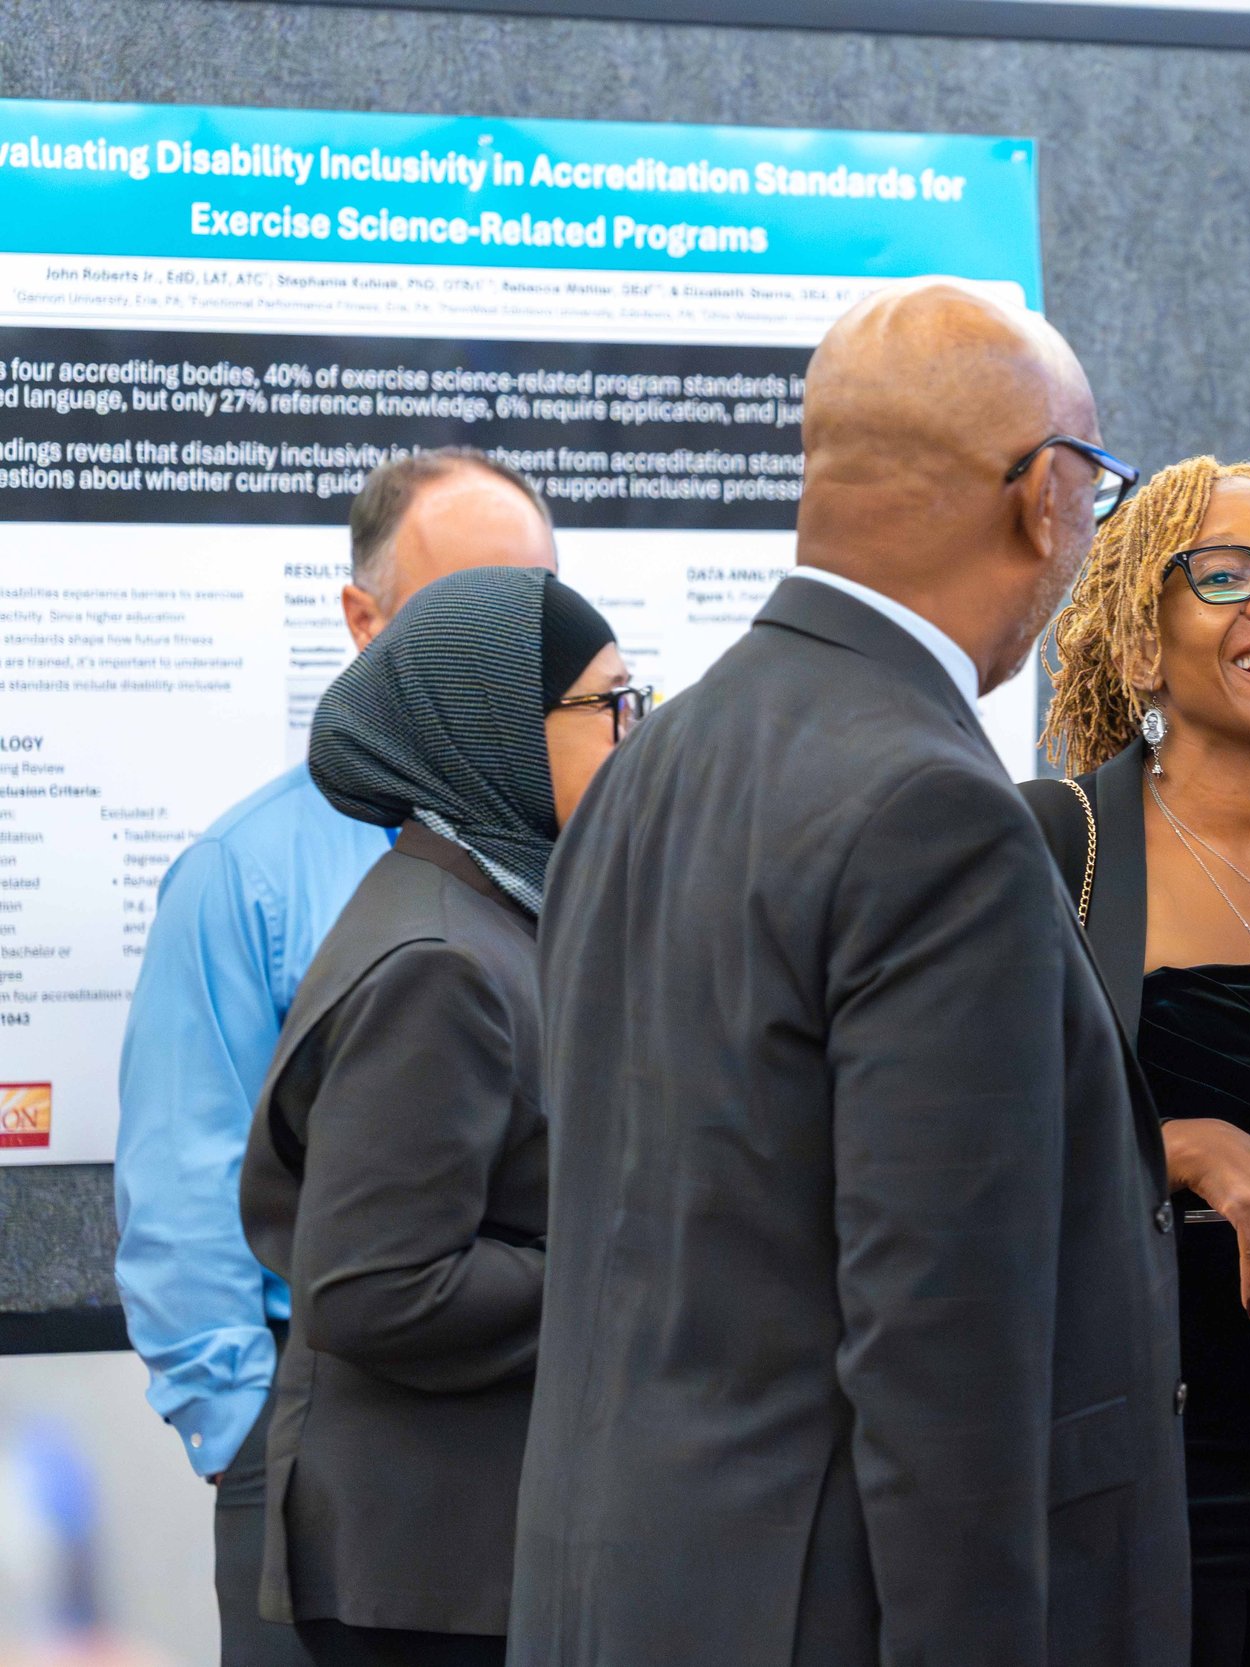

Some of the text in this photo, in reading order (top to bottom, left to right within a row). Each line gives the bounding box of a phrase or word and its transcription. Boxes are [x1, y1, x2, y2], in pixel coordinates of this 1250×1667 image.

[156, 139, 314, 186] Disability
[319, 145, 488, 193] Inclusivity
[492, 151, 524, 187] in
[529, 153, 749, 195] Accreditation
[754, 161, 916, 201] Standards
[919, 167, 966, 202] for
[190, 201, 769, 259] Exercise Science-Related Programs
[46, 265, 78, 281] John
[82, 267, 139, 282] Roberts
[11, 357, 55, 383] four
[59, 359, 180, 390] accrediting
[182, 361, 261, 389] bodies,
[263, 363, 312, 389] 40%
[315, 363, 340, 390] of
[341, 365, 429, 391] exercise
[431, 366, 593, 395] science-related
[594, 373, 682, 401] program
[683, 372, 788, 398] standards
[24, 384, 129, 415] language,
[132, 386, 169, 413] but
[171, 387, 219, 417] only
[220, 389, 269, 414] 27%
[270, 390, 374, 417] reference
[376, 391, 495, 423] knowledge,
[495, 393, 532, 420] 6%
[532, 395, 608, 424] require
[609, 396, 732, 427] application,
[733, 399, 776, 424] and
[0, 437, 62, 468] dings
[66, 439, 132, 464] reveal
[136, 439, 178, 466] that
[182, 440, 279, 472] disability
[280, 441, 386, 469] inclusivity
[558, 446, 609, 473] from
[609, 449, 746, 474] accreditation
[79, 466, 142, 491] about
[145, 467, 233, 492] whether
[235, 470, 315, 494] current
[546, 474, 629, 504] support
[629, 474, 722, 501] inclusive
[284, 562, 352, 579] RESULTS
[22, 760, 66, 776] Review
[49, 784, 102, 799] Criteria:
